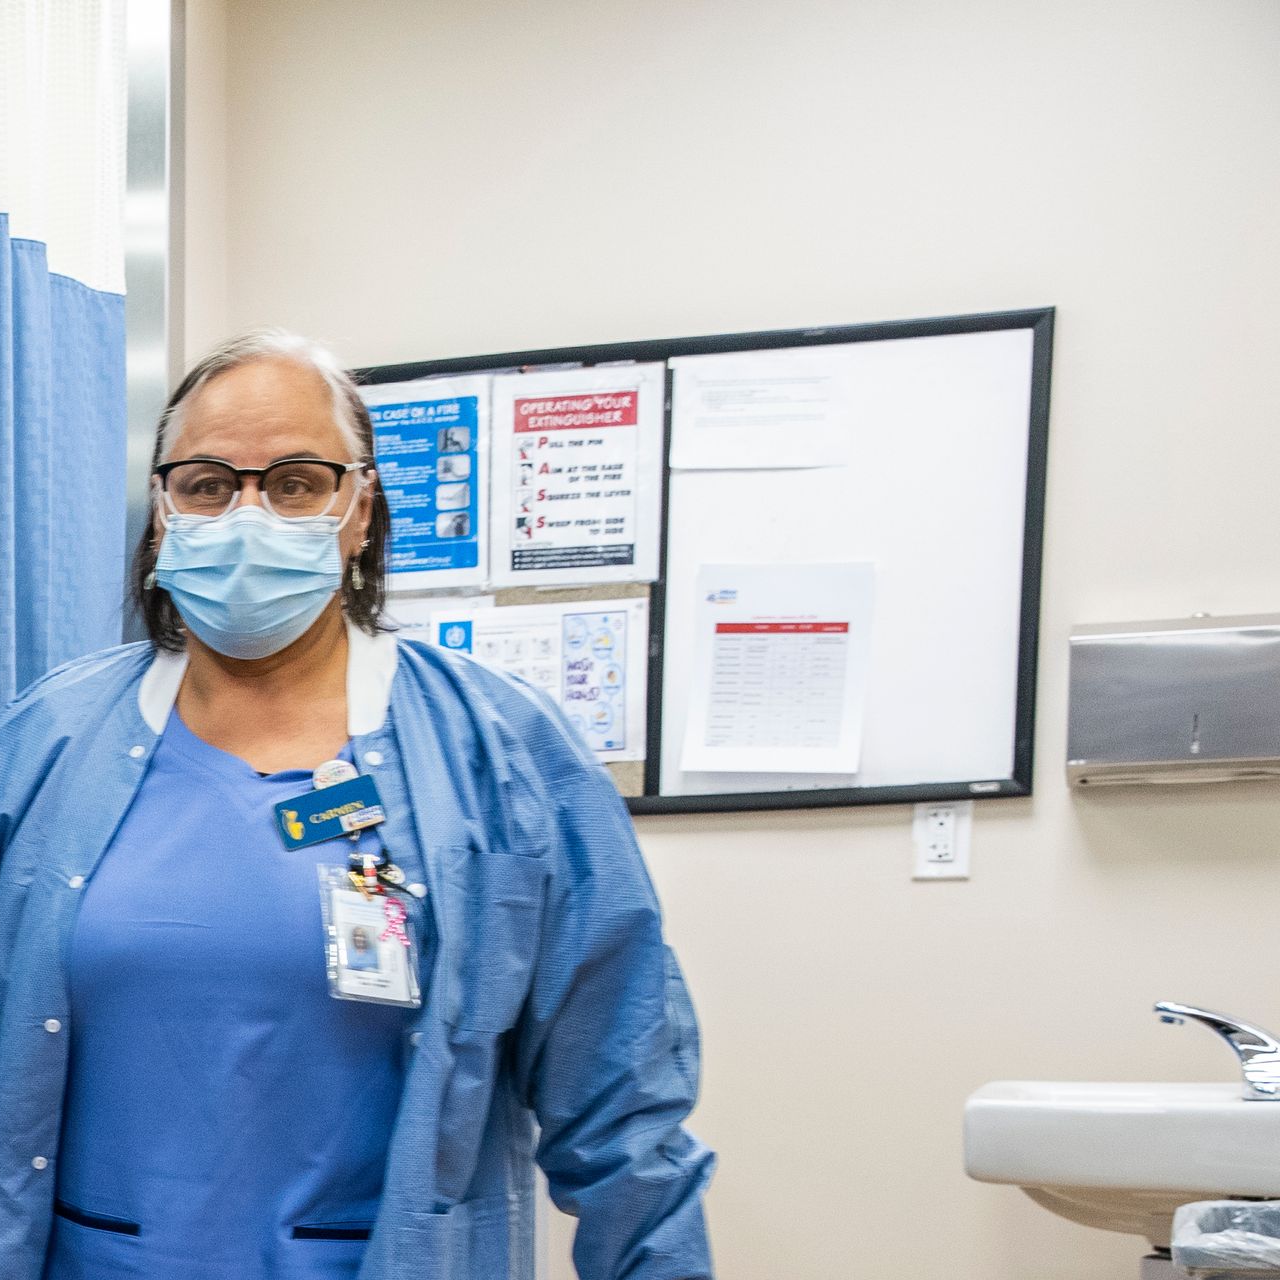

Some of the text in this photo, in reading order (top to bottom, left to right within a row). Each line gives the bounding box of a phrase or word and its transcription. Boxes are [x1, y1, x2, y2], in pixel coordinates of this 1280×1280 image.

[437, 403, 460, 415] FIRE
[520, 395, 632, 416] OPERATING YOUR
[528, 410, 623, 429] EXTINGUISHER
